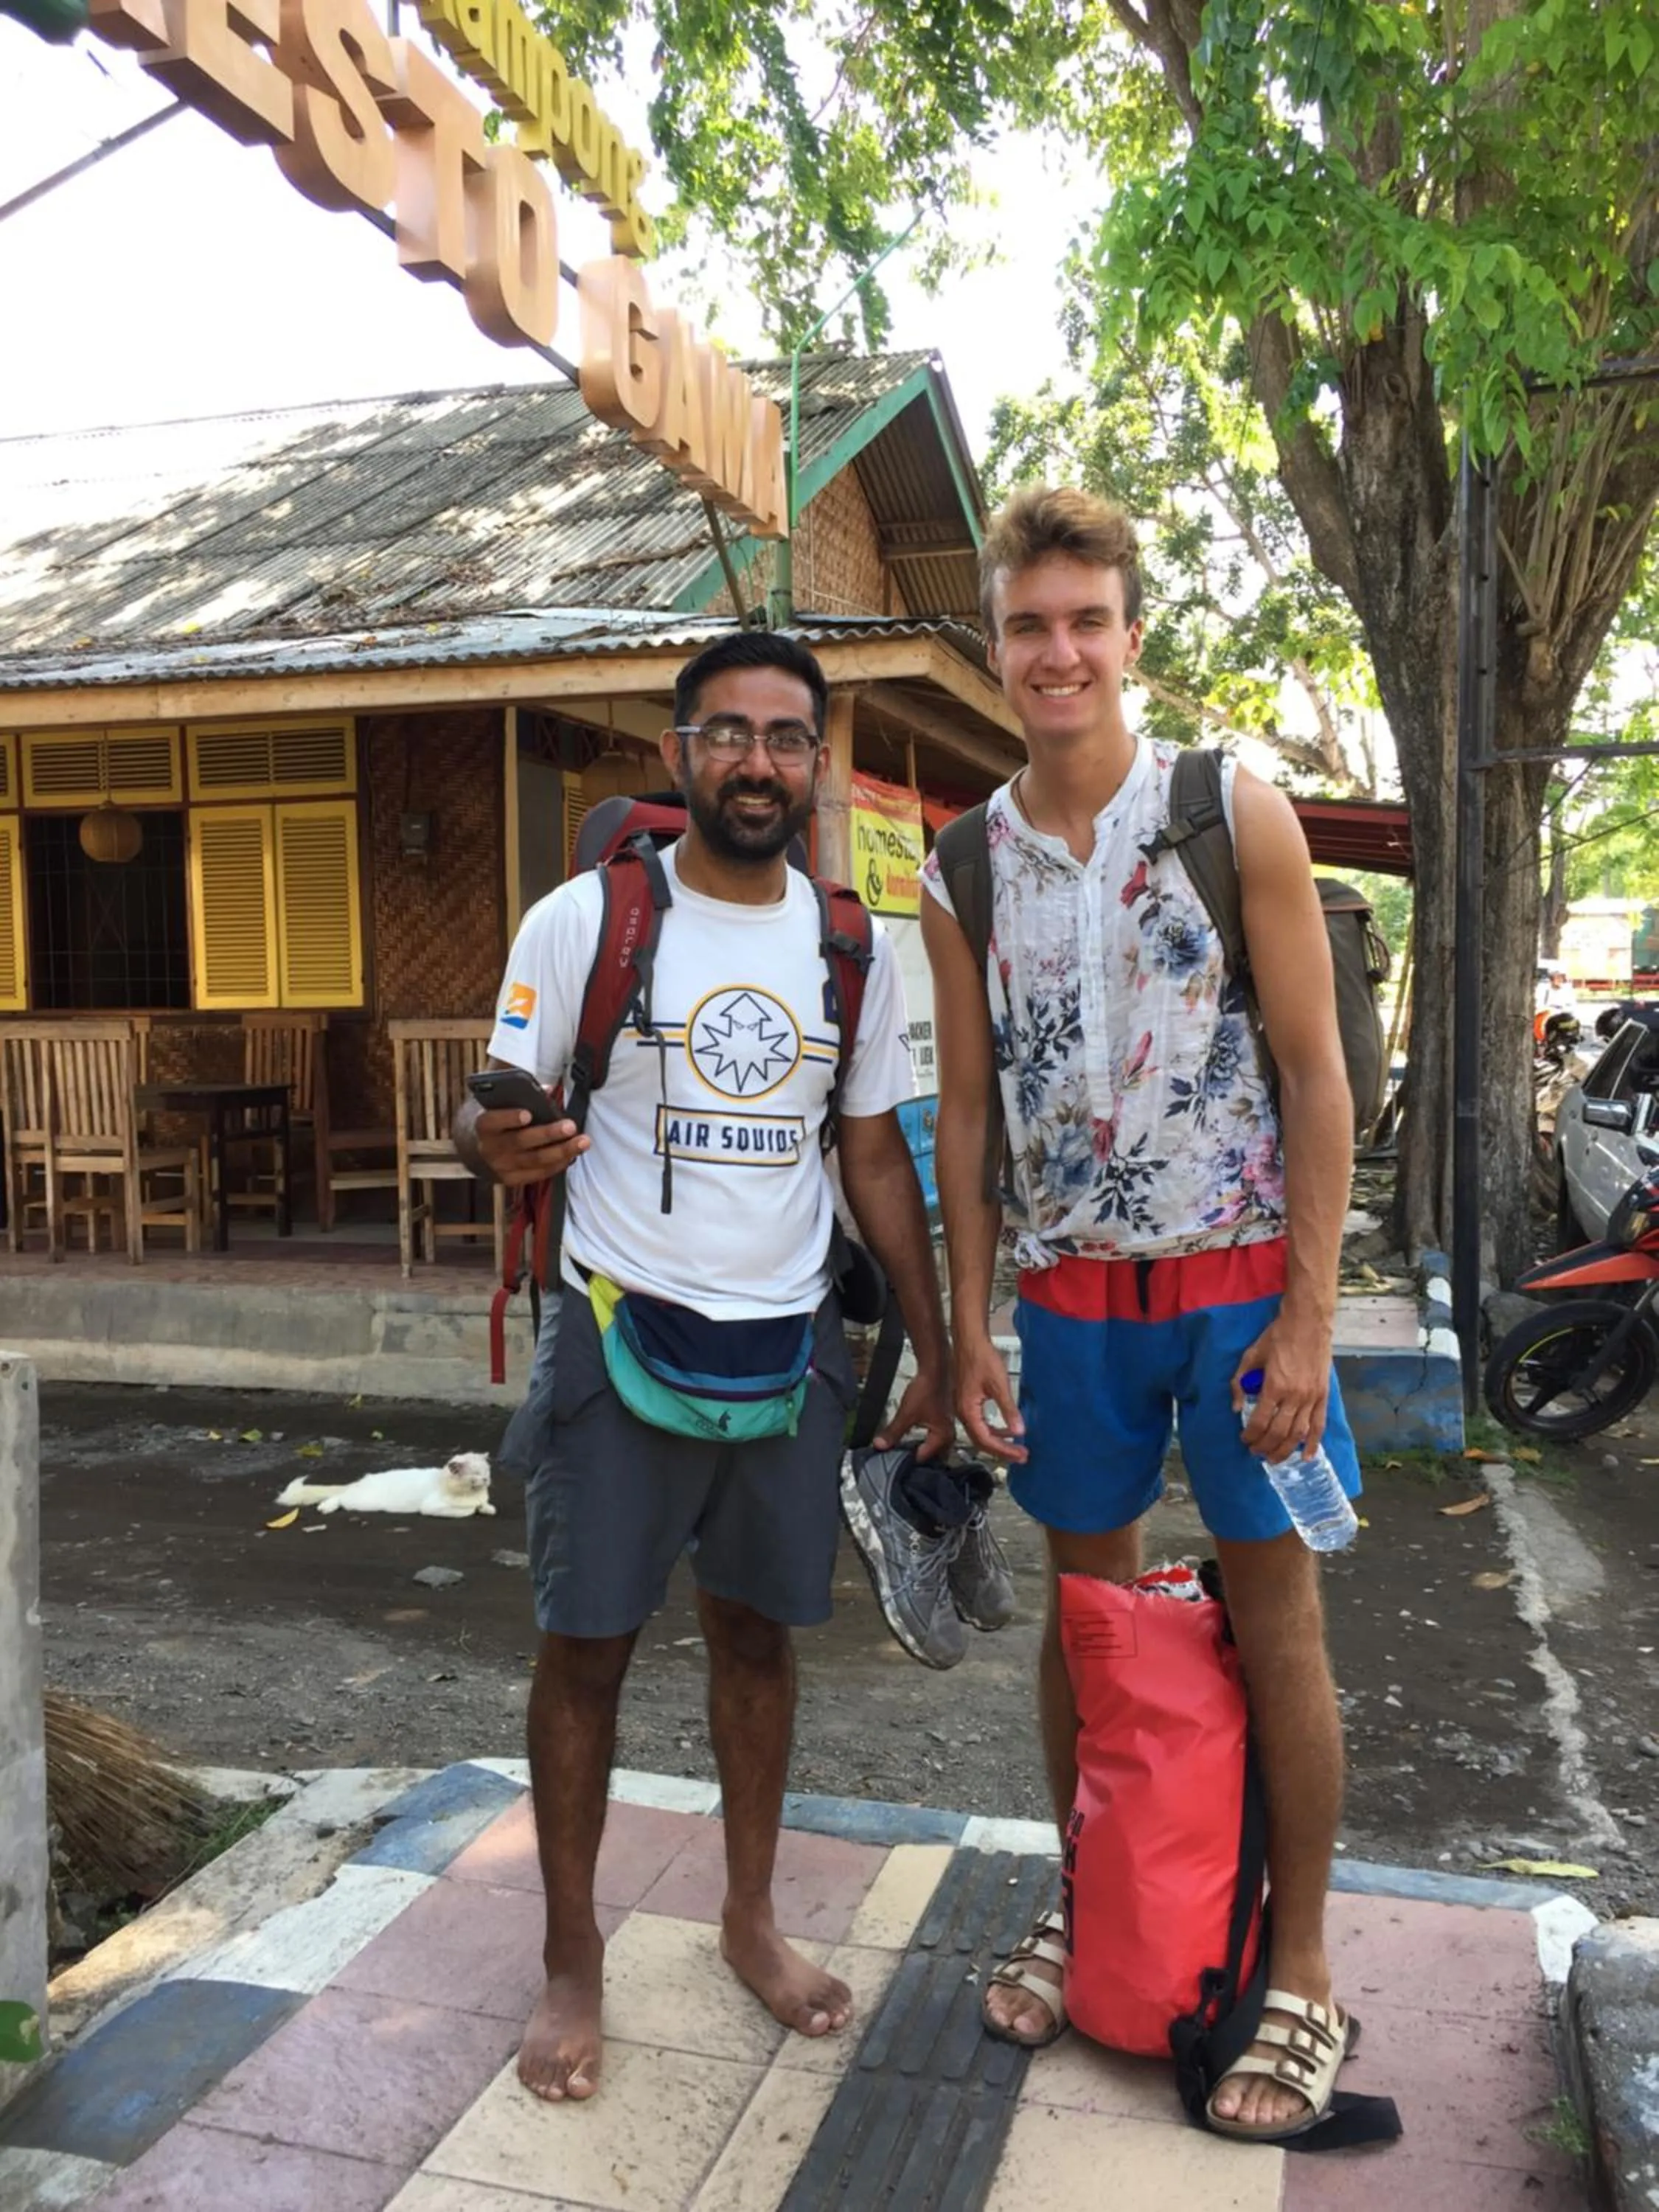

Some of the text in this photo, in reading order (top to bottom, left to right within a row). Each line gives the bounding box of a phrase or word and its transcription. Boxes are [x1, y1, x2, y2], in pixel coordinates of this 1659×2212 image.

[87, 0, 559, 348] ESTO
[420, 0, 656, 258] ampong
[855, 813, 922, 871] homes
[667, 1119, 710, 1149] AIR
